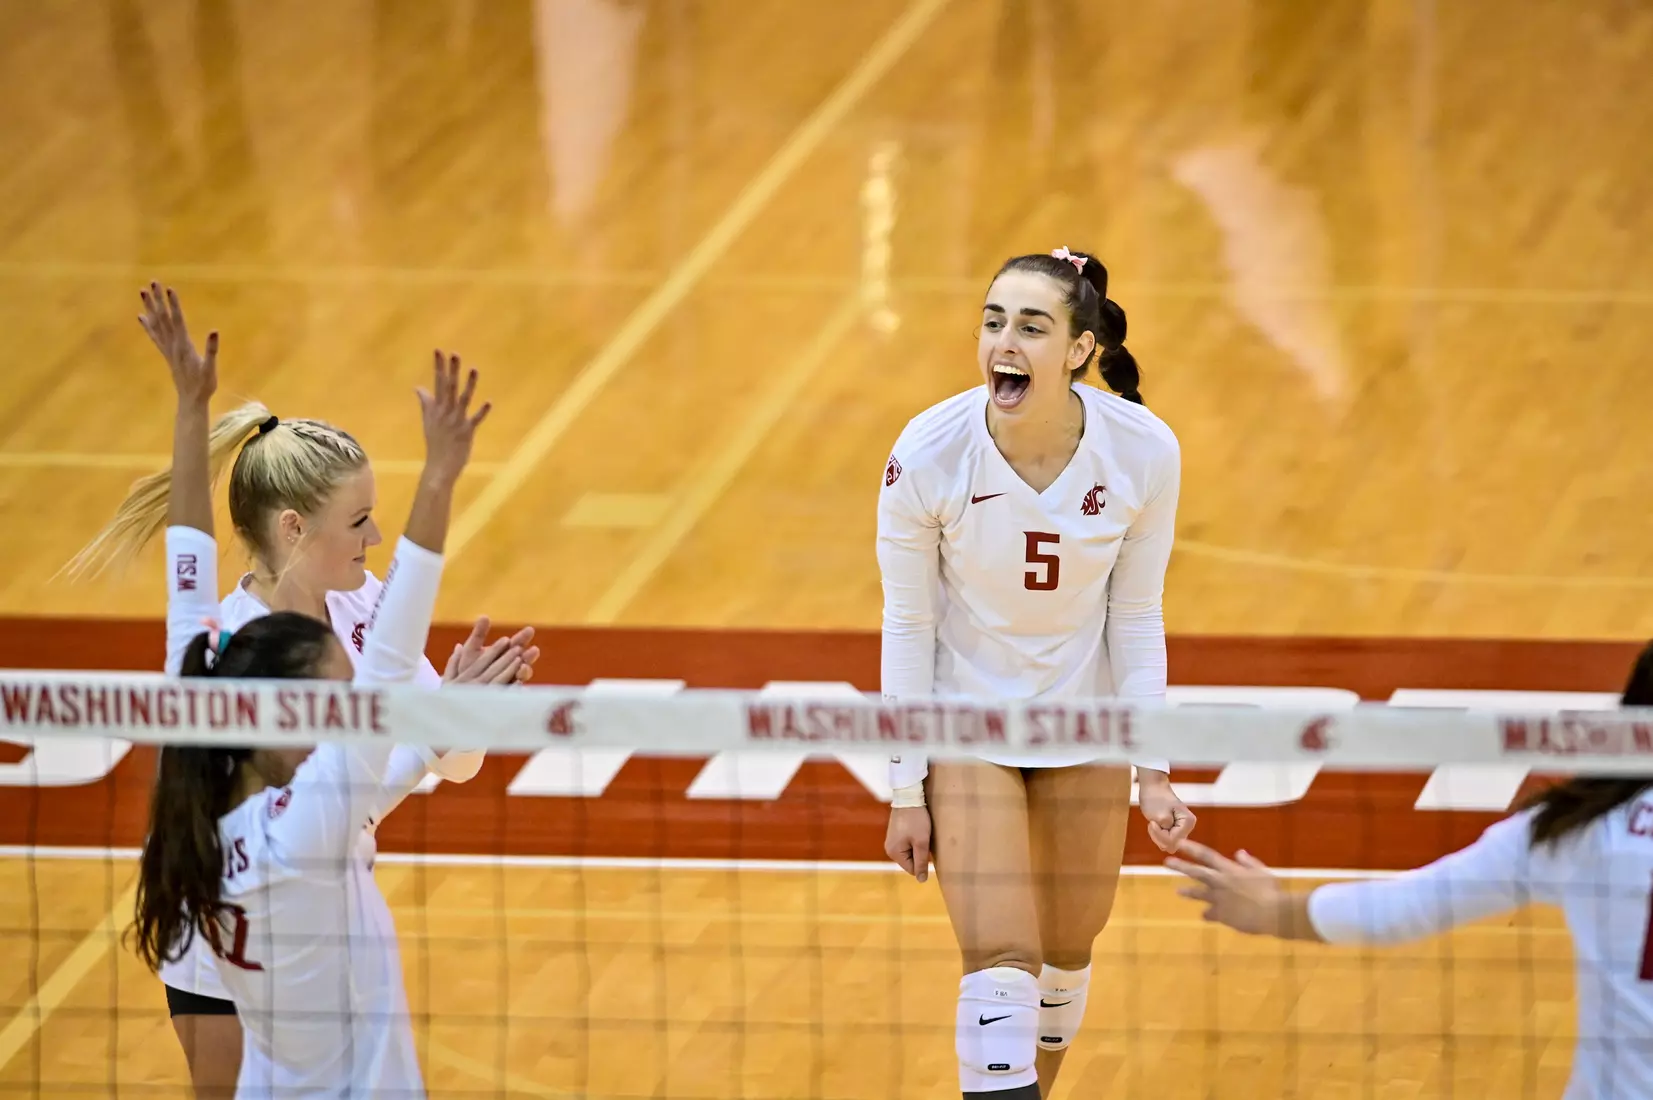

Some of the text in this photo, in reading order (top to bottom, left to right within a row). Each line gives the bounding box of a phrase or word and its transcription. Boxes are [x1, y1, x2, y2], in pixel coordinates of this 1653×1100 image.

[177, 554, 197, 592] WSU
[1022, 531, 1060, 591] 5
[2, 683, 391, 733] WASHINGTON STATE
[744, 702, 1142, 750] WASHINGTON STATE
